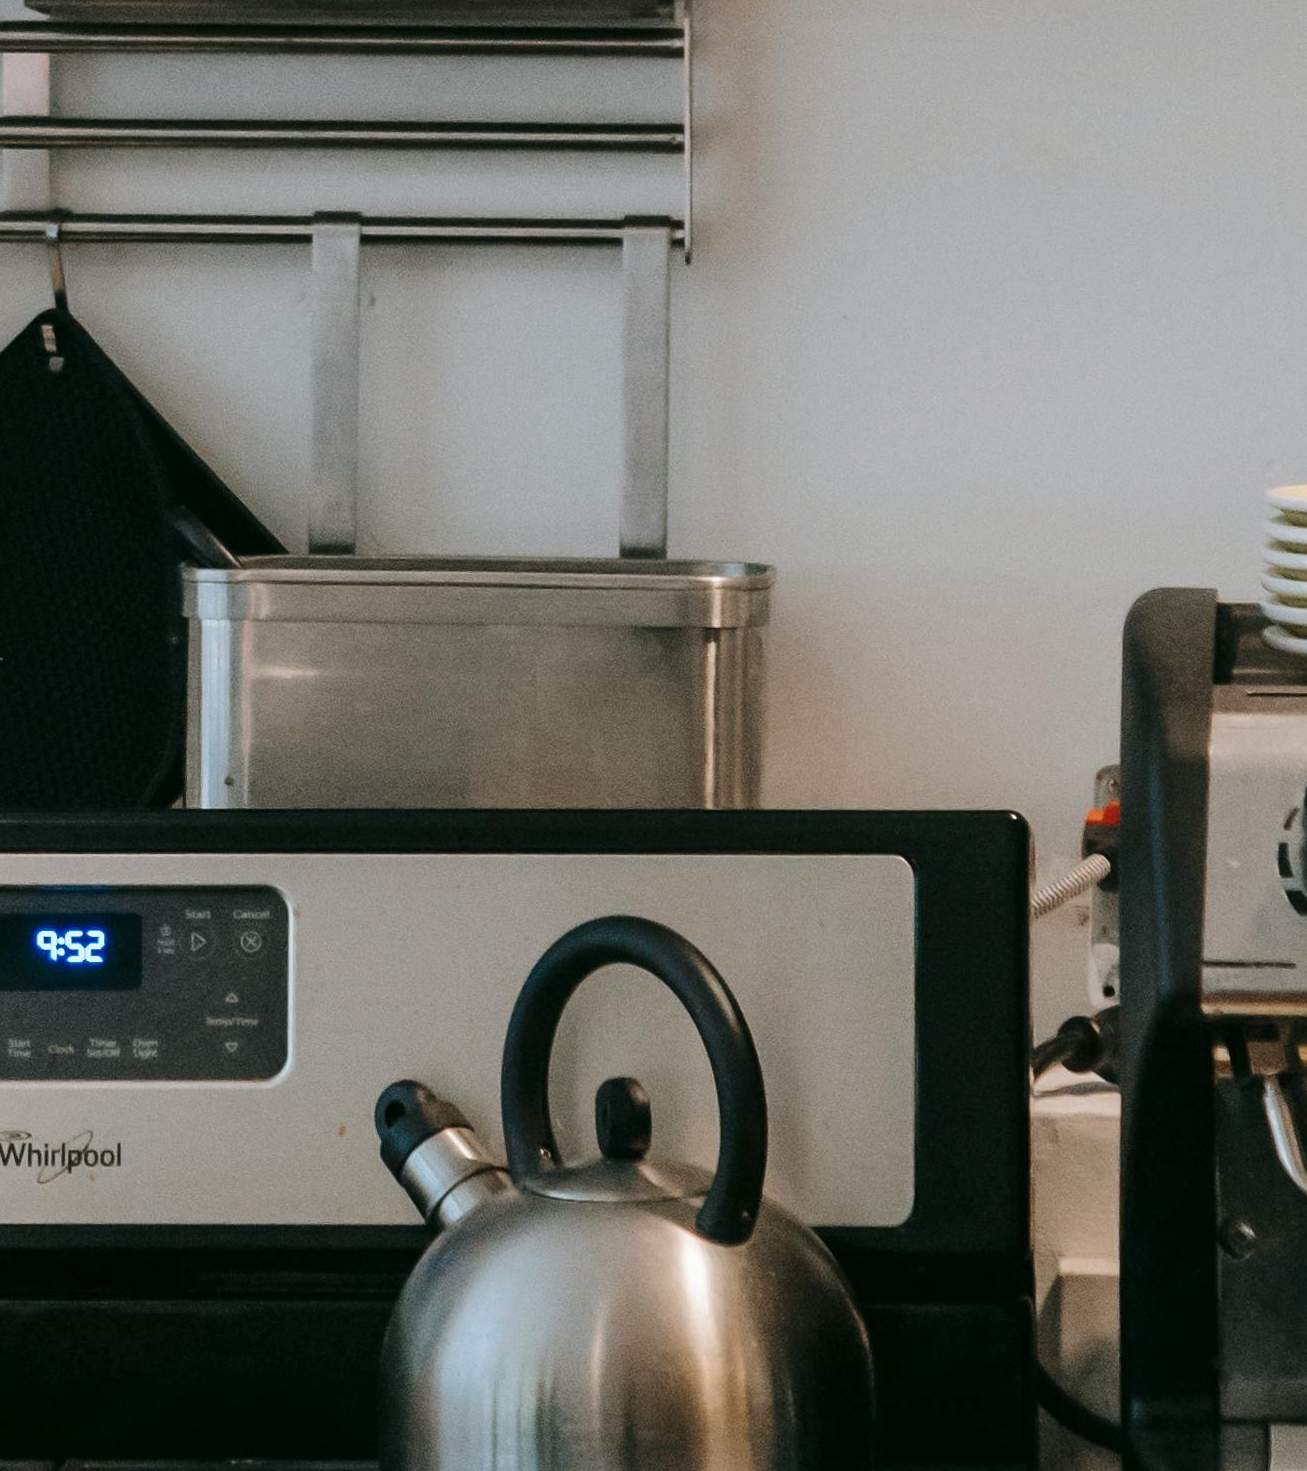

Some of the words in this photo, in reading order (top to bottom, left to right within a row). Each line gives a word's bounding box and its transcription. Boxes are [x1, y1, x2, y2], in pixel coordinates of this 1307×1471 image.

[185, 909, 211, 920] Start
[232, 909, 271, 920] Cancel
[36, 929, 105, 963] 9:52
